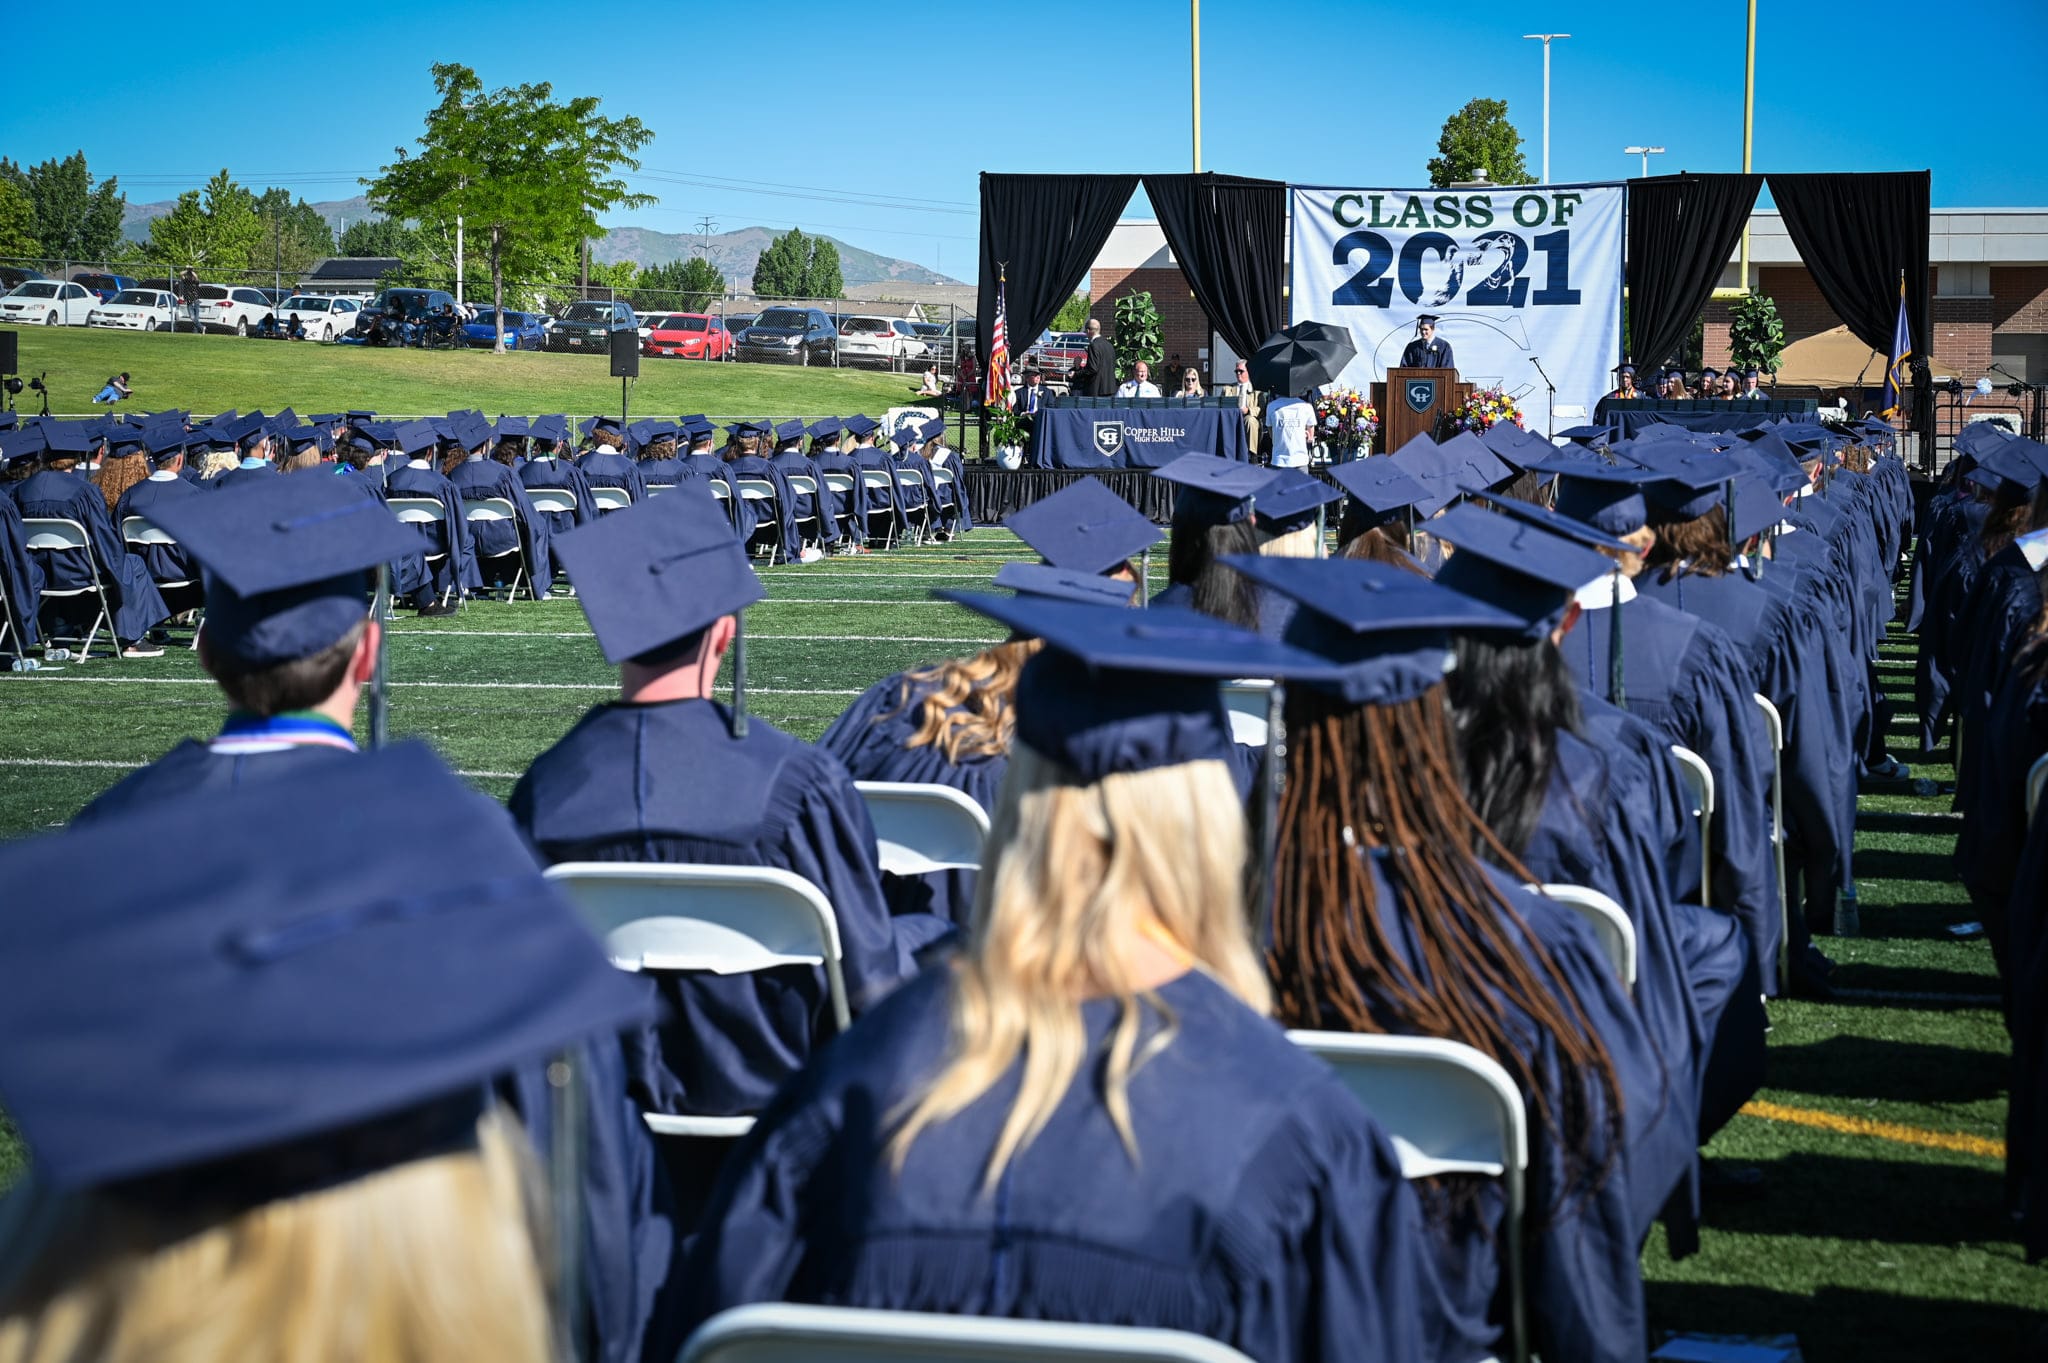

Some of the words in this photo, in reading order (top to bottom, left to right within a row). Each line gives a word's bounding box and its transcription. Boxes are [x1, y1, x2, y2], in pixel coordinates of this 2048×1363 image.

[1332, 194, 1494, 229] CLASS
[1512, 193, 1583, 227] OF
[1332, 229, 1582, 308] 2021
